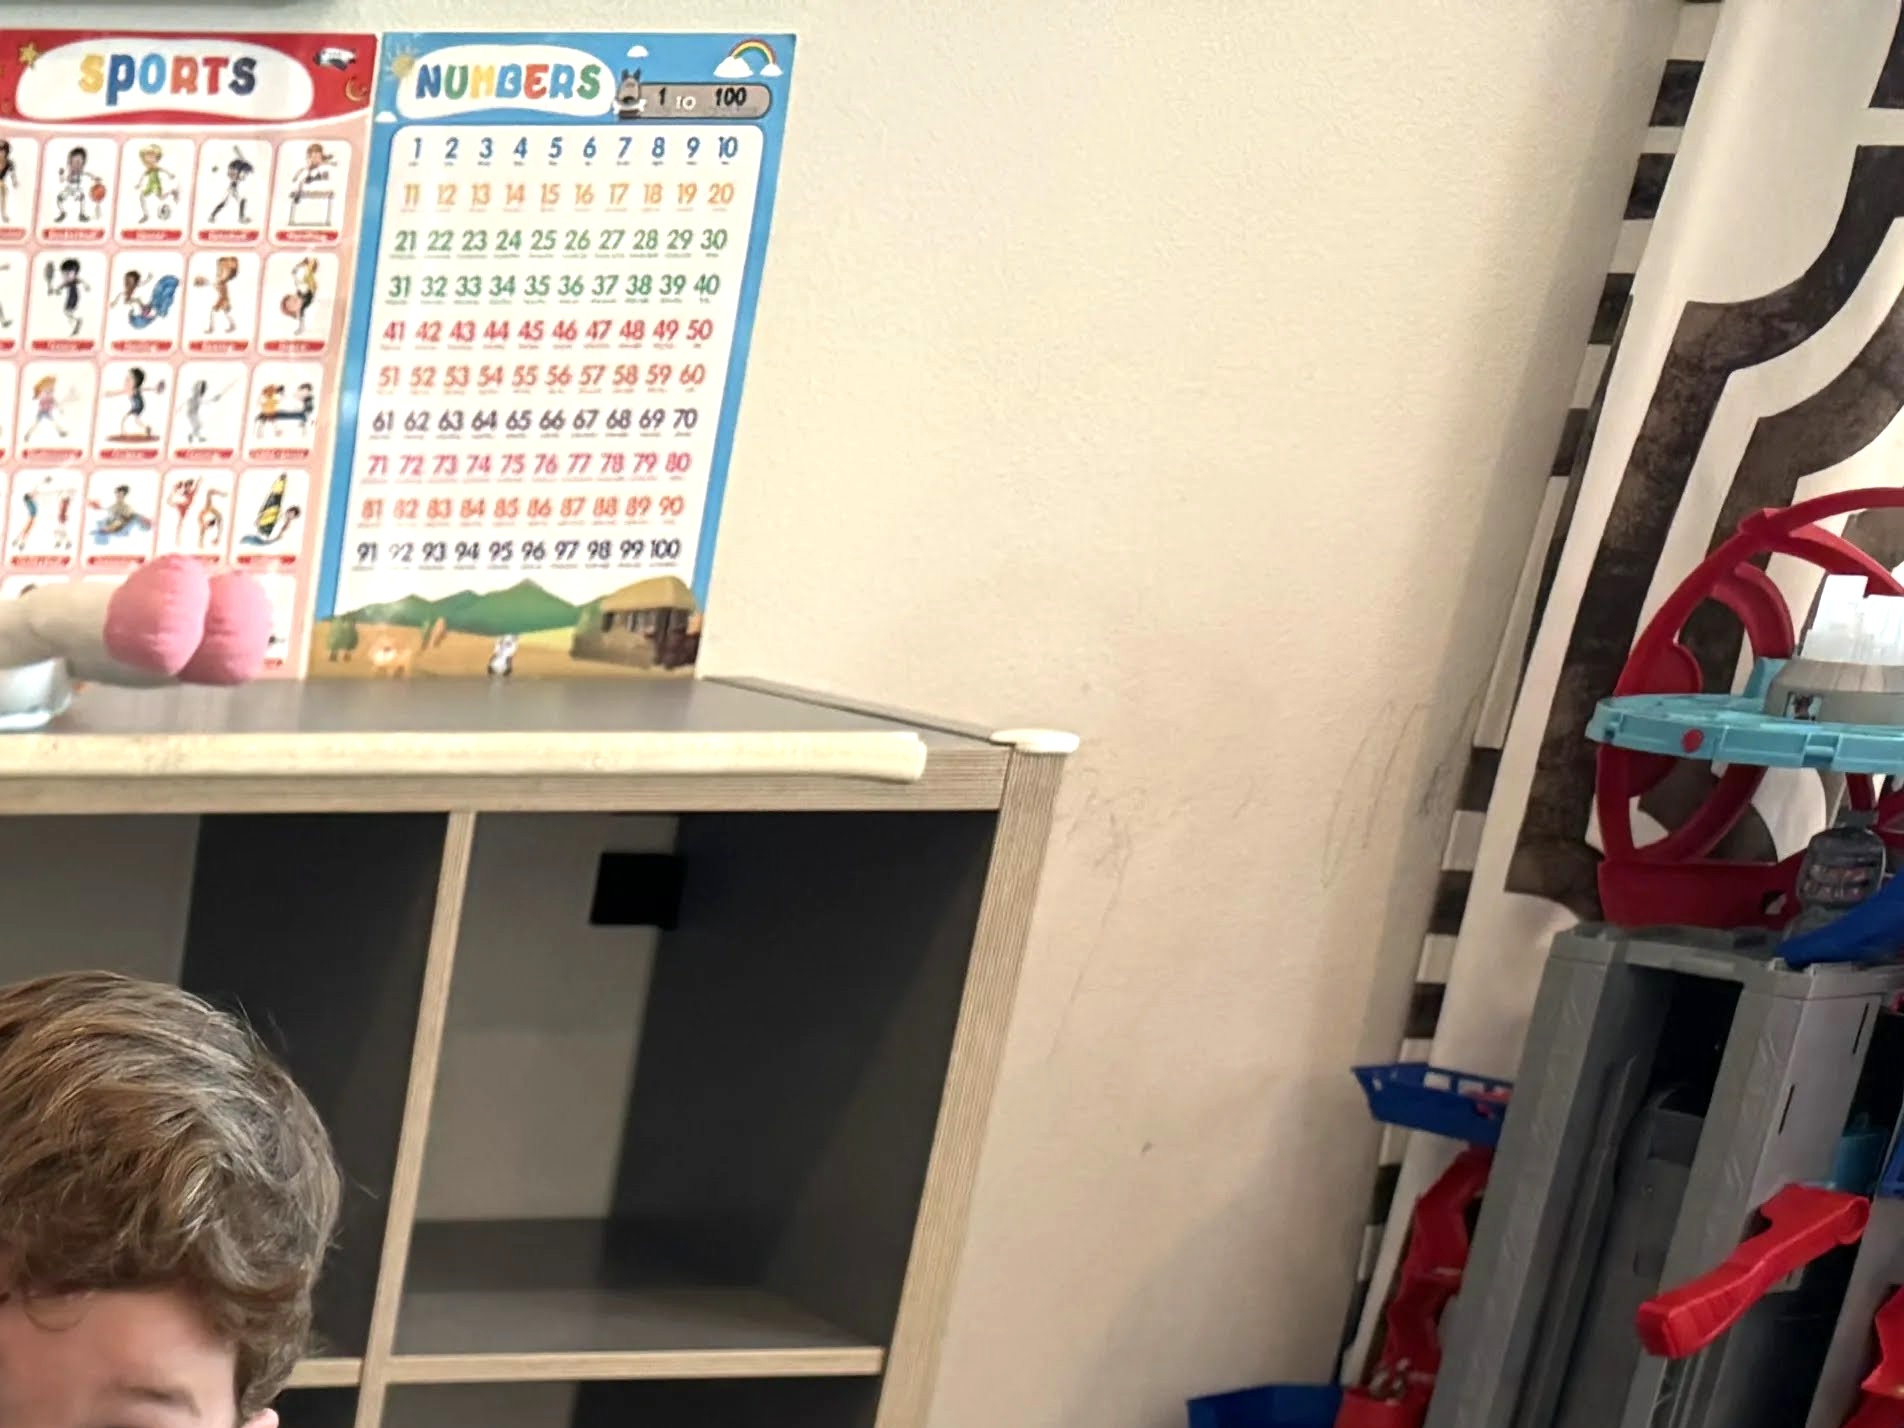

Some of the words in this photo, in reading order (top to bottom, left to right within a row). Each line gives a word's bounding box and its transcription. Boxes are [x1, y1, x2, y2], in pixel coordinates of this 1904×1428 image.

[78, 52, 258, 106] SPORTS
[415, 64, 601, 99] NUMBERS
[657, 87, 667, 106] 1
[715, 86, 747, 106] 100
[414, 137, 422, 158] 1
[445, 137, 459, 159] 2
[479, 137, 493, 159] 3
[514, 137, 527, 158] 4
[549, 137, 562, 158] 5
[583, 137, 596, 158] 6
[619, 137, 632, 158] 7
[652, 137, 665, 158] 8
[687, 137, 700, 158] 9
[719, 136, 738, 158] 10
[404, 184, 420, 206] 11
[437, 183, 458, 206] 12
[472, 183, 491, 206] 13
[506, 184, 525, 205] 14
[541, 183, 560, 205] 15
[575, 183, 594, 205] 16
[610, 182, 630, 205] 17
[644, 183, 663, 204] 18
[678, 183, 697, 204] 19
[708, 182, 734, 204] 20
[395, 230, 417, 252] 21
[428, 230, 454, 251] 22
[462, 230, 487, 251] 23
[496, 229, 521, 251] 24
[531, 229, 557, 250] 25
[565, 229, 591, 250] 26
[599, 229, 626, 250] 27
[633, 229, 658, 250] 28
[667, 229, 693, 250] 29
[701, 229, 728, 250] 30
[389, 275, 411, 297] 31
[421, 275, 448, 297] 32
[455, 275, 481, 297] 33
[489, 275, 515, 296] 34
[524, 275, 551, 296] 35
[558, 275, 584, 297] 36
[592, 275, 619, 296] 37
[626, 274, 652, 299] 38
[659, 274, 686, 299] 39
[694, 274, 720, 299] 40
[383, 321, 405, 341] 41
[416, 320, 442, 342] 42
[450, 320, 476, 342] 43
[484, 320, 509, 341] 44
[518, 320, 544, 341] 45
[552, 320, 577, 341] 46
[586, 320, 612, 340] 47
[620, 320, 645, 340] 48
[653, 319, 679, 341] 49
[686, 319, 713, 340] 50
[379, 366, 400, 387] 51
[410, 366, 436, 387] 52
[444, 365, 470, 388] 53
[478, 365, 504, 387] 54
[512, 365, 538, 387] 55
[546, 365, 572, 386] 56
[579, 365, 606, 386] 57
[613, 364, 638, 386] 58
[645, 364, 672, 385] 59
[679, 364, 706, 385] 60
[373, 411, 394, 432] 61
[404, 411, 430, 432] 62
[438, 410, 464, 431] 63
[471, 410, 497, 431] 64
[506, 410, 532, 431] 65
[539, 410, 566, 430] 66
[573, 409, 600, 430] 67
[606, 409, 632, 429] 68
[639, 408, 665, 429] 69
[673, 408, 698, 429] 70
[368, 455, 388, 475] 71
[400, 455, 424, 476] 72
[434, 454, 458, 476] 73
[467, 454, 491, 474] 74
[501, 453, 525, 474] 75
[534, 453, 558, 474] 76
[568, 453, 592, 474] 77
[601, 453, 625, 473] 78
[633, 452, 658, 473] 79
[665, 452, 692, 473] 80
[362, 498, 384, 520] 81
[427, 498, 452, 520] 83
[460, 498, 485, 518] 84
[494, 497, 519, 519] 85
[527, 498, 552, 518] 86
[560, 496, 586, 518] 87
[593, 496, 618, 517] 88
[625, 496, 652, 517] 89
[659, 495, 684, 516] 90
[357, 542, 377, 562] 91
[423, 542, 446, 562] 93
[455, 541, 480, 561] 94
[489, 540, 513, 561] 95
[522, 541, 546, 560] 96
[555, 540, 580, 560] 97
[587, 540, 611, 560] 98
[620, 540, 645, 558] 99
[651, 539, 681, 559] 100
